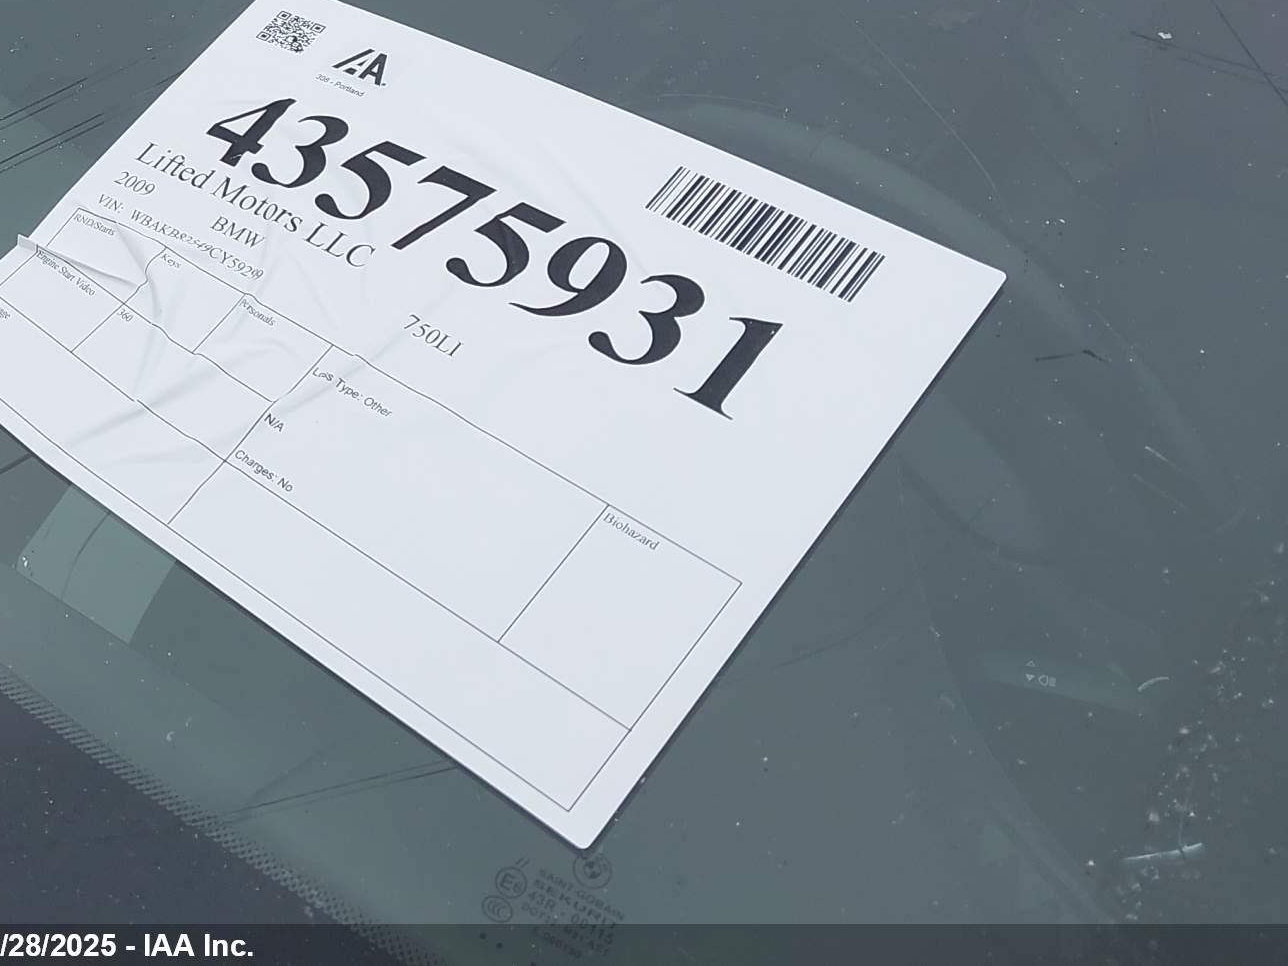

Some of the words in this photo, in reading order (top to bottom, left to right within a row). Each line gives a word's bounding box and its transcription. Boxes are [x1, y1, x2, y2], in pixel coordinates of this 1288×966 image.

[333, 80, 366, 98] Portland
[98, 193, 125, 214] VIN:
[136, 141, 217, 189] Lifted
[209, 176, 303, 233] Motors
[304, 221, 376, 268] LLC
[37, 249, 60, 271] Engine
[58, 263, 77, 283] Start
[75, 276, 96, 297] Video
[113, 170, 156, 196] 2009
[209, 215, 265, 249] BMW
[403, 313, 464, 357] 750LI
[160, 252, 182, 269] Keys
[206, 97, 784, 421] 43575931
[117, 307, 134, 323] 360
[239, 297, 277, 327] Personals
[334, 377, 363, 402] Type:
[363, 396, 393, 418] Other
[263, 412, 285, 433] N/A
[234, 448, 279, 483] Charges:
[277, 476, 294, 493] No
[602, 512, 661, 551] Biohazard
